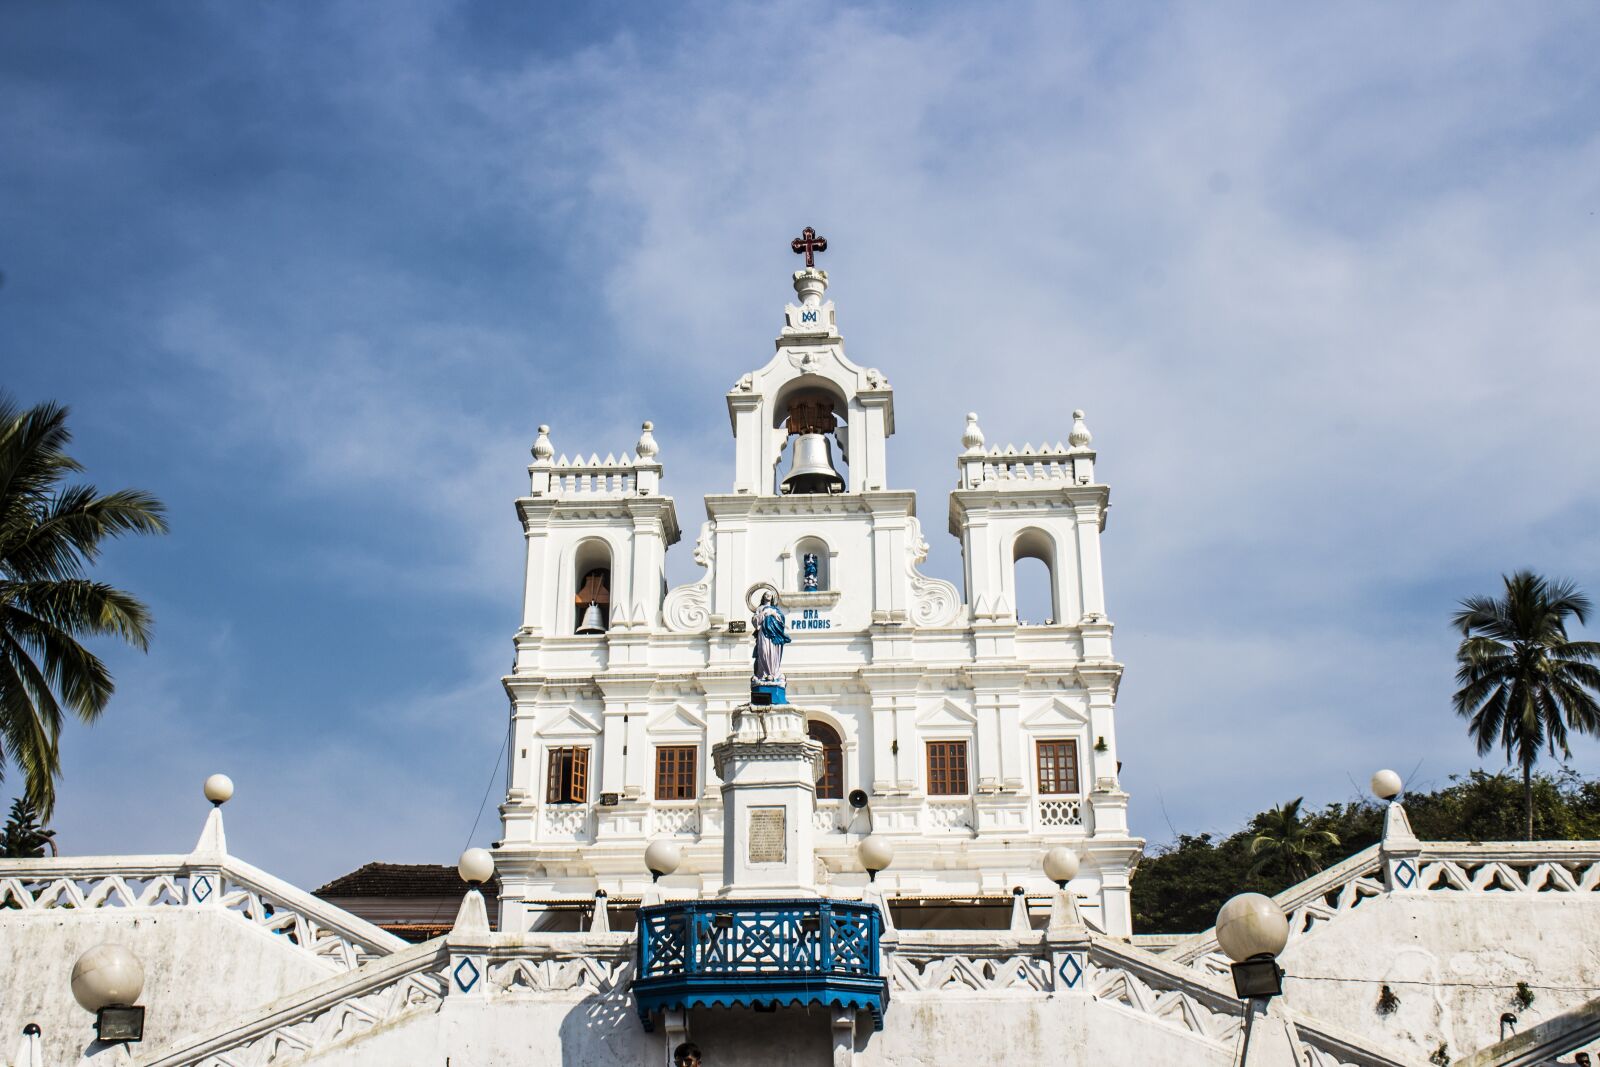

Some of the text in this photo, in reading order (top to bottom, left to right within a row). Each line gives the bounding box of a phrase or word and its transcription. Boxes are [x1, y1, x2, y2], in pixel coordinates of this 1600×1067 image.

[803, 609, 818, 619] ORA
[791, 620, 830, 629] PRO NOBIS
